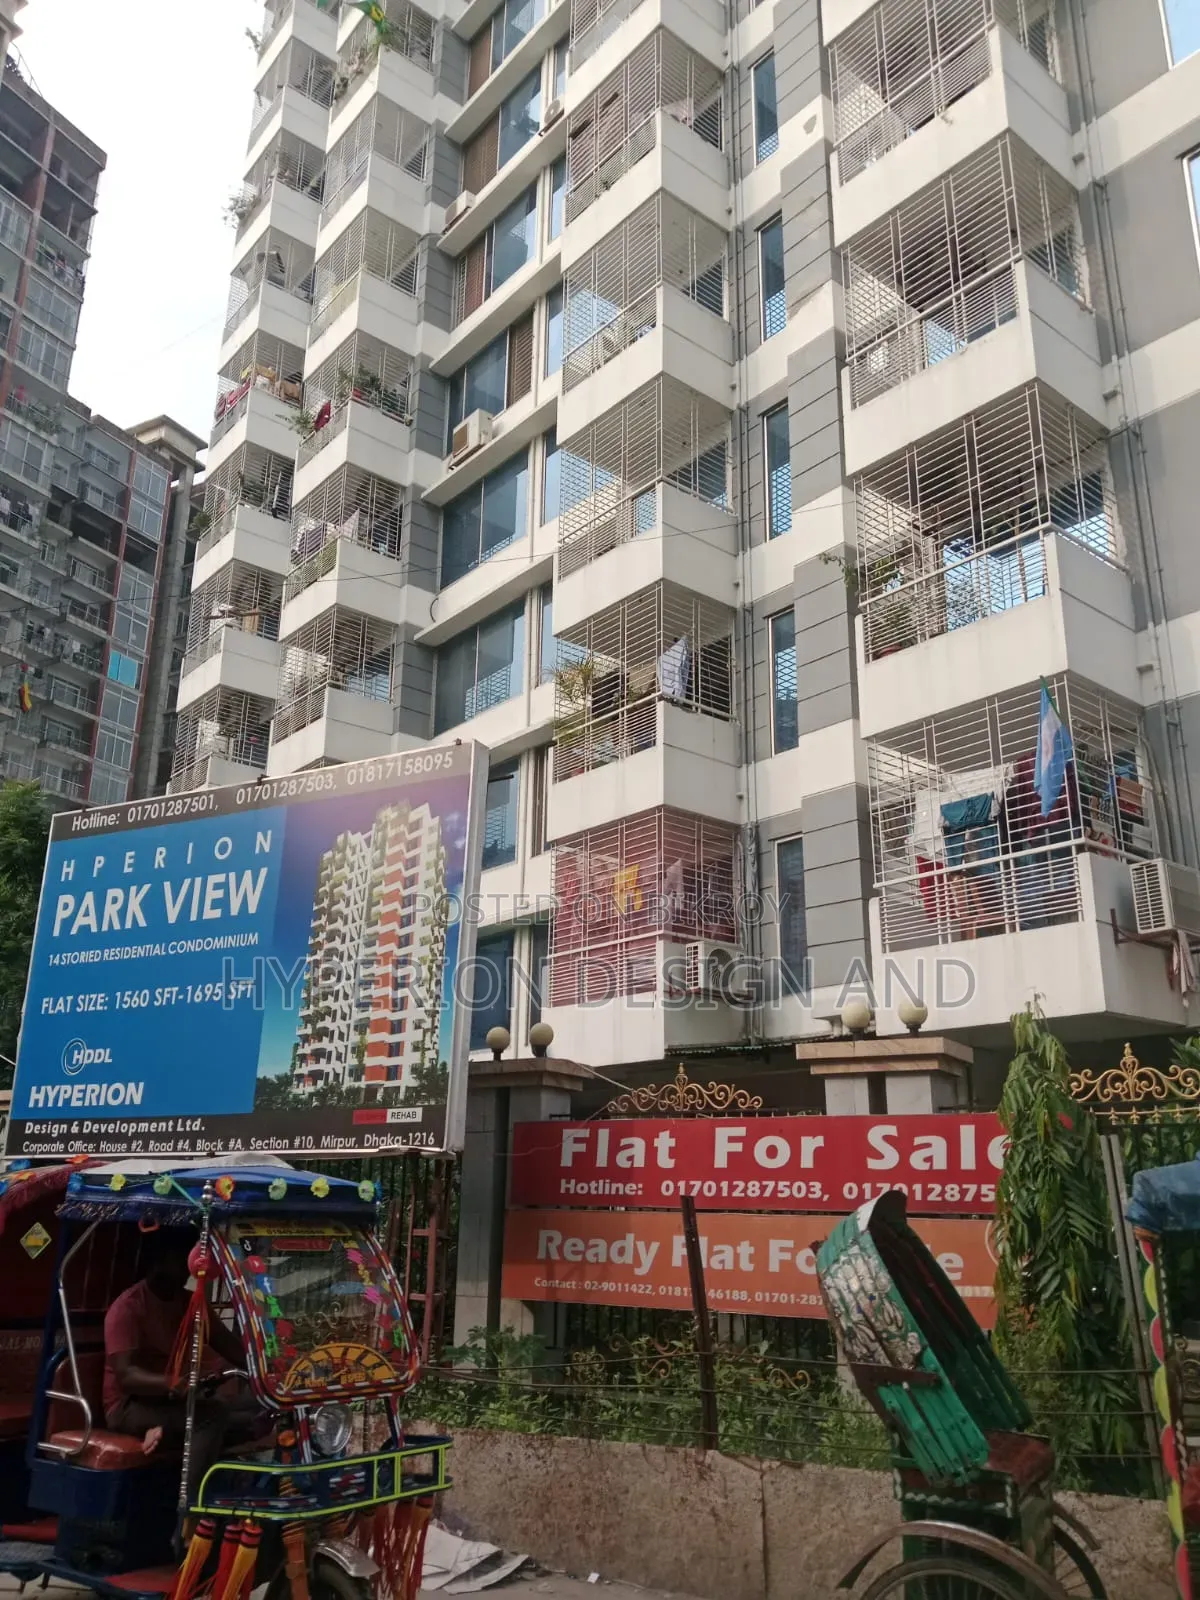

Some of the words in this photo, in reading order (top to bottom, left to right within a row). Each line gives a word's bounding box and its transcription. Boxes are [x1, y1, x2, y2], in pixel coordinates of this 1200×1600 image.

[72, 812, 120, 831] Hotline:
[127, 794, 219, 823] 01701287501,
[236, 773, 337, 805] 01701287503,
[347, 751, 453, 785] 01817158095
[52, 883, 152, 937] PARK
[163, 867, 268, 924] VIEW
[48, 954, 60, 967] 14
[60, 949, 101, 966] STORIED
[102, 943, 166, 961] RESIDENTIAL
[168, 932, 259, 955] CONDOMINIUM
[41, 995, 73, 1014] FLAT
[76, 993, 108, 1012] SIZE:
[115, 989, 150, 1009] 1560
[228, 980, 255, 1000] SFT
[28, 1082, 144, 1108] HYPERION
[25, 1121, 67, 1138] Design
[71, 1121, 79, 1134] &
[82, 1119, 173, 1136] Development
[177, 1118, 206, 1132] Ltd.
[391, 1111, 417, 1119] REHAB
[23, 1140, 64, 1154] Corporate
[68, 1140, 96, 1153] Office:
[100, 1140, 127, 1152] House
[131, 1140, 144, 1153] #2,
[148, 1139, 173, 1152] Road
[177, 1140, 191, 1152] #4,
[196, 1138, 223, 1151] Block
[250, 1136, 289, 1150] Section
[294, 1136, 315, 1149] #10,
[320, 1134, 358, 1150] Mirpur,
[364, 1132, 435, 1147] Dhaka-1216
[560, 1128, 676, 1169] Flat
[714, 1126, 825, 1169] For
[560, 1179, 643, 1196] Hotline:
[661, 1180, 830, 1201] 01701287503,
[843, 1182, 996, 1202] 01712875
[536, 1229, 660, 1276] Ready
[671, 1235, 755, 1272] Flat
[768, 1239, 817, 1275] Fo
[584, 1280, 655, 1296] 02-9011422,
[755, 1292, 823, 1305] 01701-287
